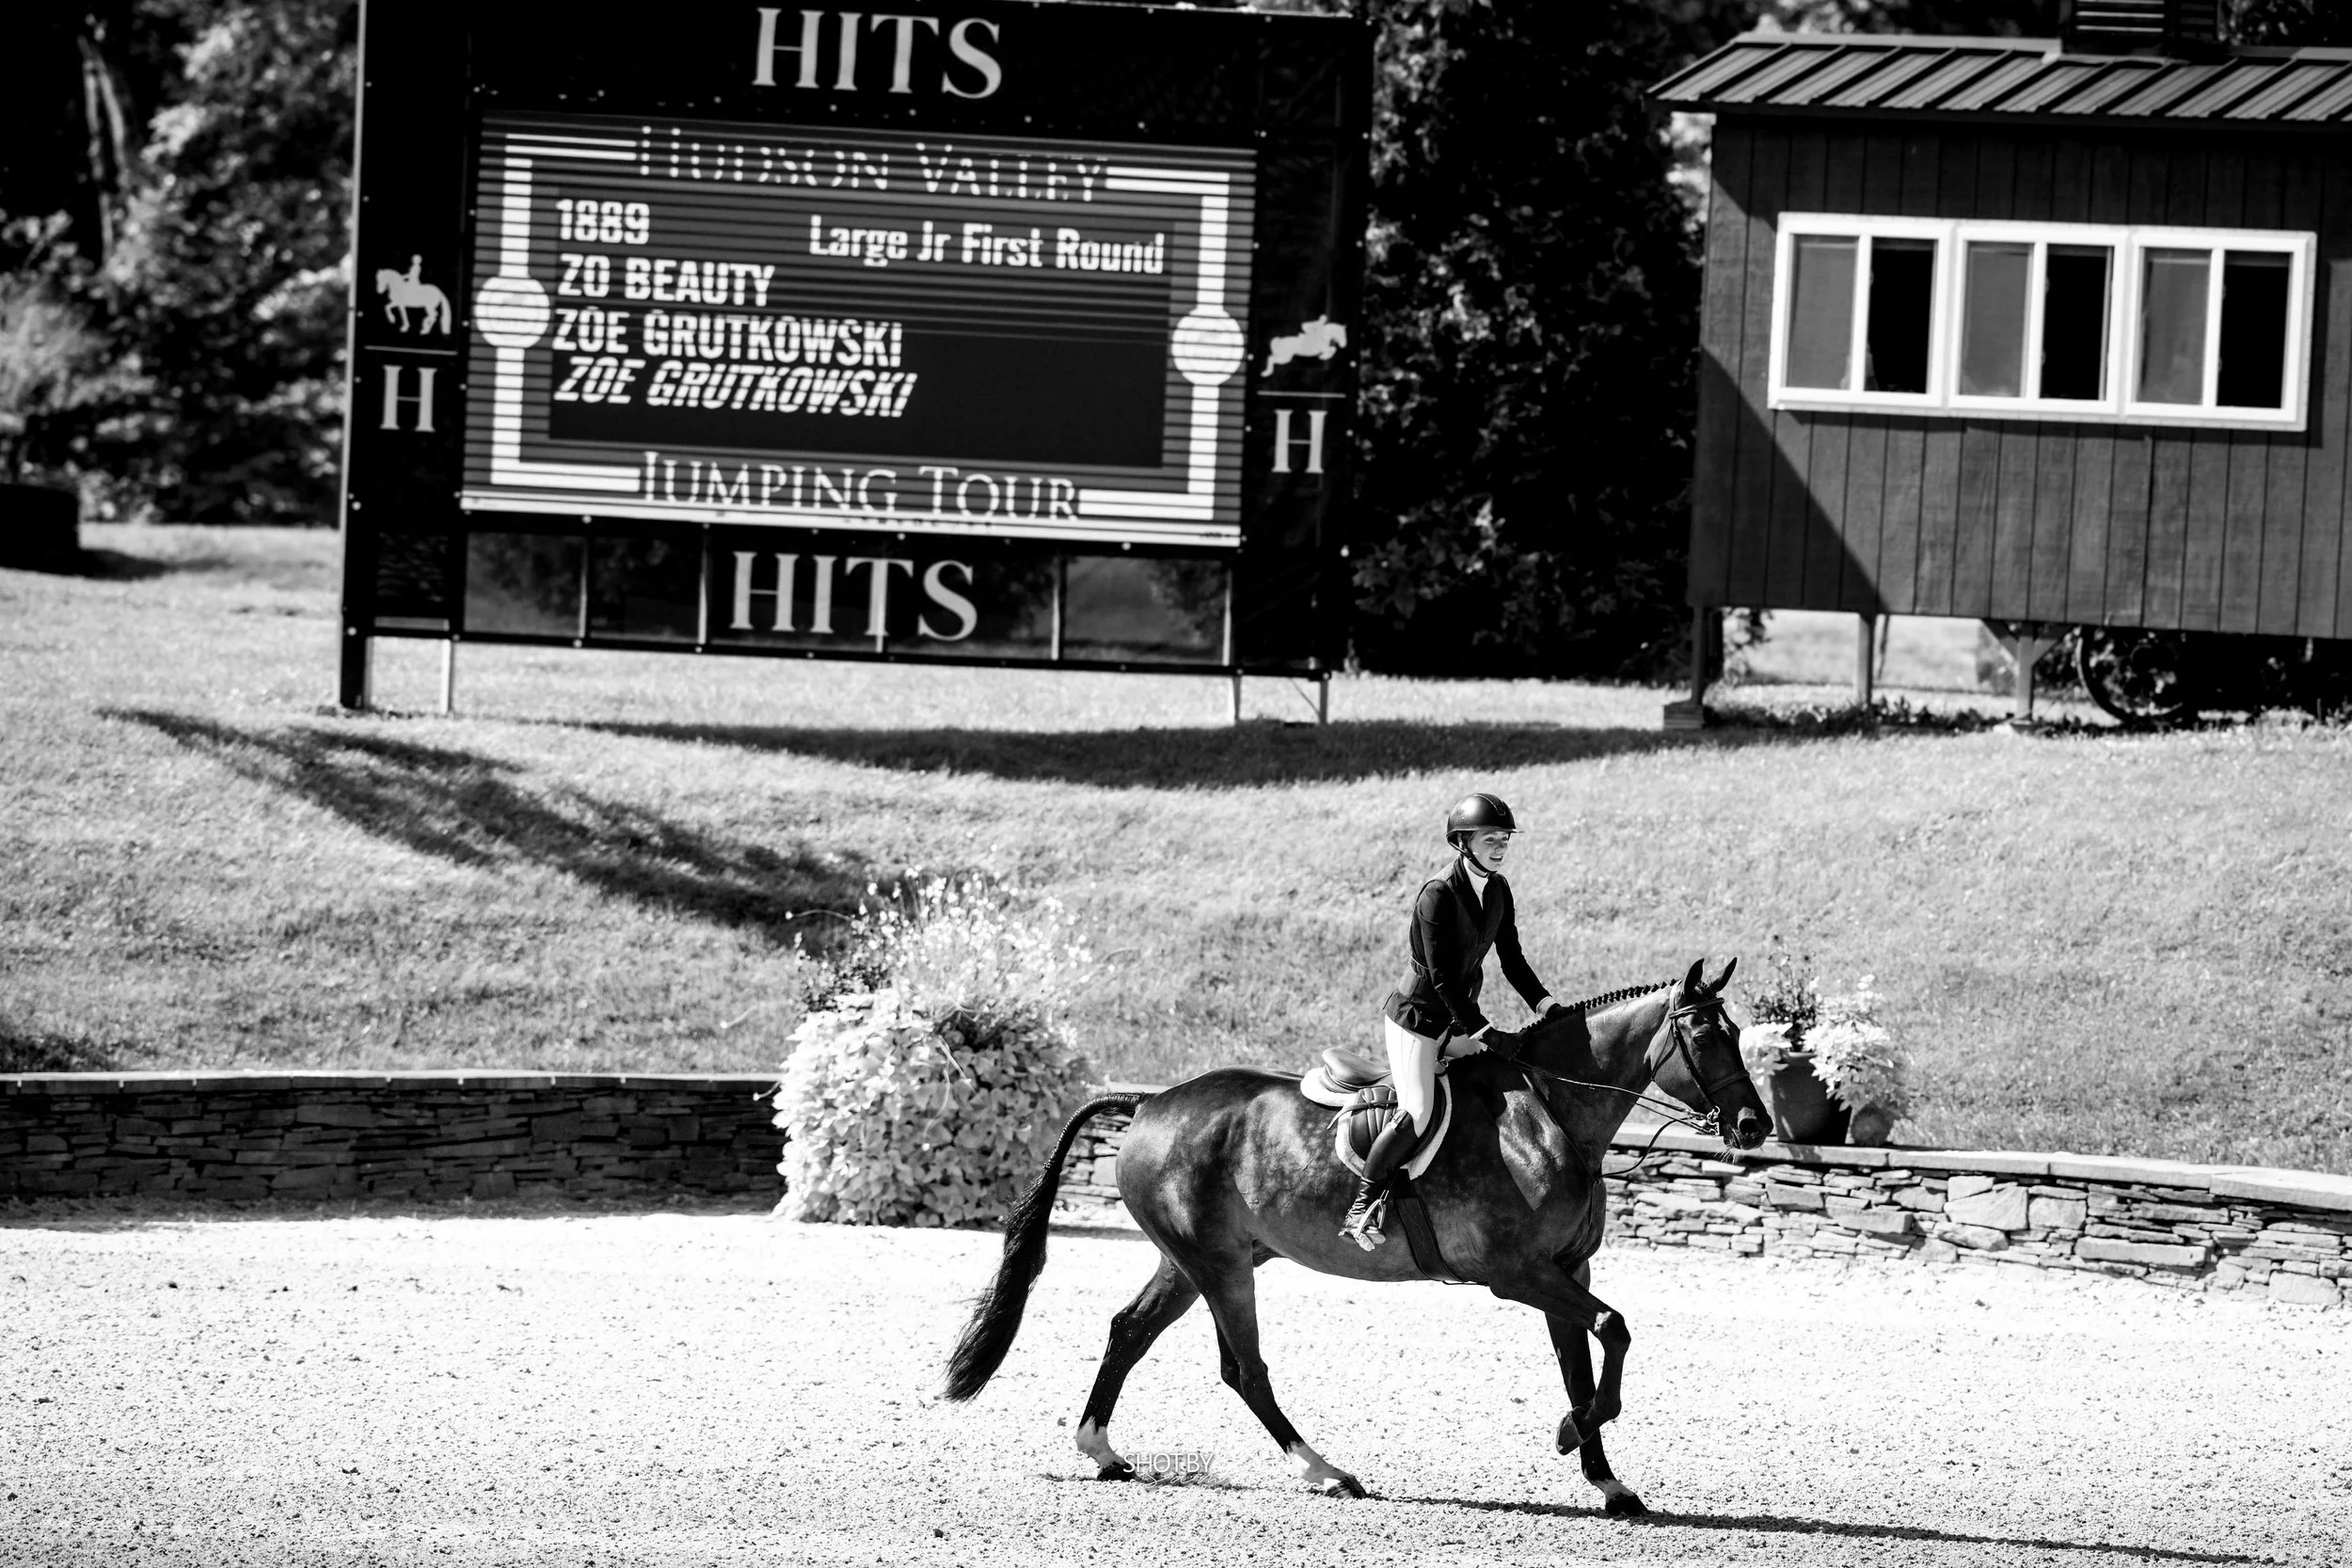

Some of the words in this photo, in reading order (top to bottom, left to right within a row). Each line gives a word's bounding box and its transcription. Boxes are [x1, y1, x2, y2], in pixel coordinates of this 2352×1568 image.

[752, 7, 1002, 99] HITS
[555, 198, 651, 245] 1889
[809, 214, 909, 267] Large
[917, 220, 951, 262] Jr
[961, 222, 1043, 267] First
[1056, 227, 1166, 275] Round
[558, 253, 610, 297] ZO
[624, 257, 776, 307] BEAUTY
[552, 307, 630, 354] ZOE
[643, 309, 903, 368] GRUTKOWSKI
[379, 364, 437, 433] H
[553, 356, 647, 404] ZOE
[645, 359, 919, 418] GRUTKOWSKI
[1271, 408, 1328, 473] H
[917, 466, 1078, 521] TOUR
[729, 551, 978, 641] HITS
